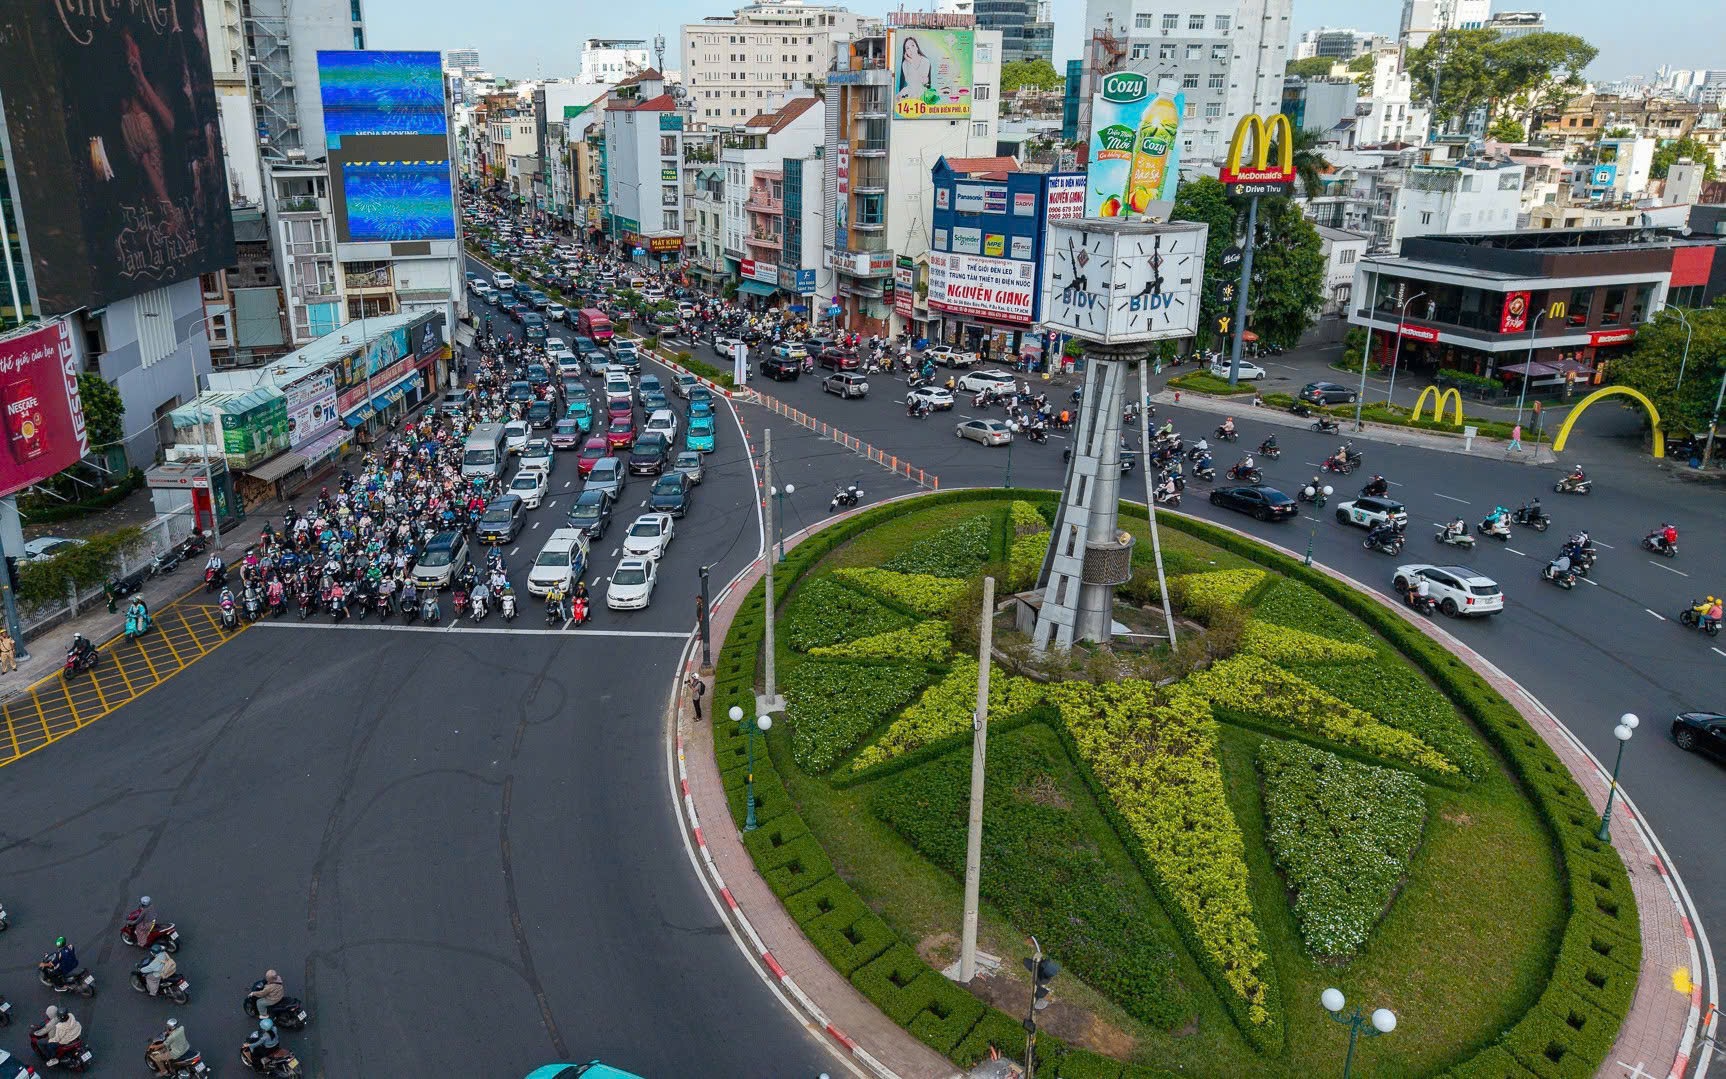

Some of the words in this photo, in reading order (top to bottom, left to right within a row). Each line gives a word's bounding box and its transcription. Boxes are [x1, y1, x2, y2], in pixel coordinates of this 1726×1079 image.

[1107, 77, 1143, 96] Cozy
[897, 102, 926, 114] 14-16
[1106, 136, 1131, 149] Mới
[1143, 139, 1165, 154] Cozy
[1238, 171, 1282, 180] McDonald's
[1245, 185, 1264, 193] Drive
[1266, 185, 1281, 193] Thru
[957, 193, 983, 201] Panasonic
[954, 235, 980, 243] Schneider
[949, 272, 966, 280] TRUNG
[967, 273, 978, 281] TÂM
[947, 283, 992, 302] NGUYỄN
[995, 290, 1029, 307] GIANG
[1063, 287, 1097, 309] BIDV
[1129, 292, 1174, 312] BIDV
